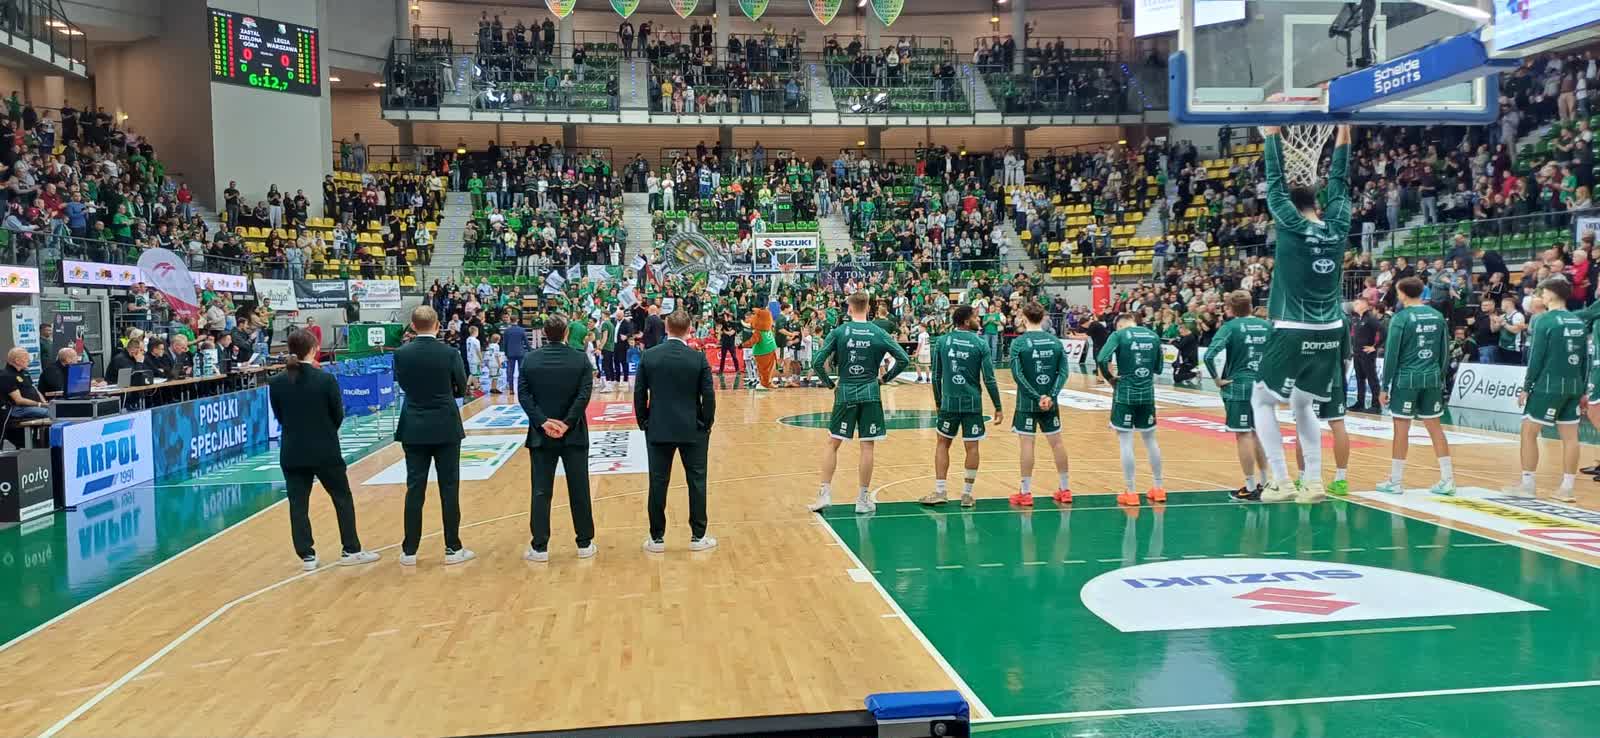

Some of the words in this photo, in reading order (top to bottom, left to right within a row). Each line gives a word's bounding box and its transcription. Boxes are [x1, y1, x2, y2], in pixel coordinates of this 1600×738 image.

[239, 34, 262, 43] ZIELONA
[240, 28, 260, 37] ZASTAL
[266, 42, 298, 52] WARSZAWA
[273, 37, 291, 45] LEGIA
[243, 49, 252, 61] 0
[281, 54, 290, 67] 0
[241, 64, 247, 72] 0
[1374, 59, 1420, 81] Schelde
[288, 71, 294, 79] 0
[249, 73, 288, 91] 6:12,7
[1374, 71, 1421, 94] Sports
[343, 388, 370, 396] molten
[200, 398, 239, 425] POSIŁKI
[190, 423, 248, 459] SPECJALNE
[76, 433, 139, 479] ARPOL
[120, 469, 134, 484] 1991
[1122, 569, 1363, 588] SUZUKI
